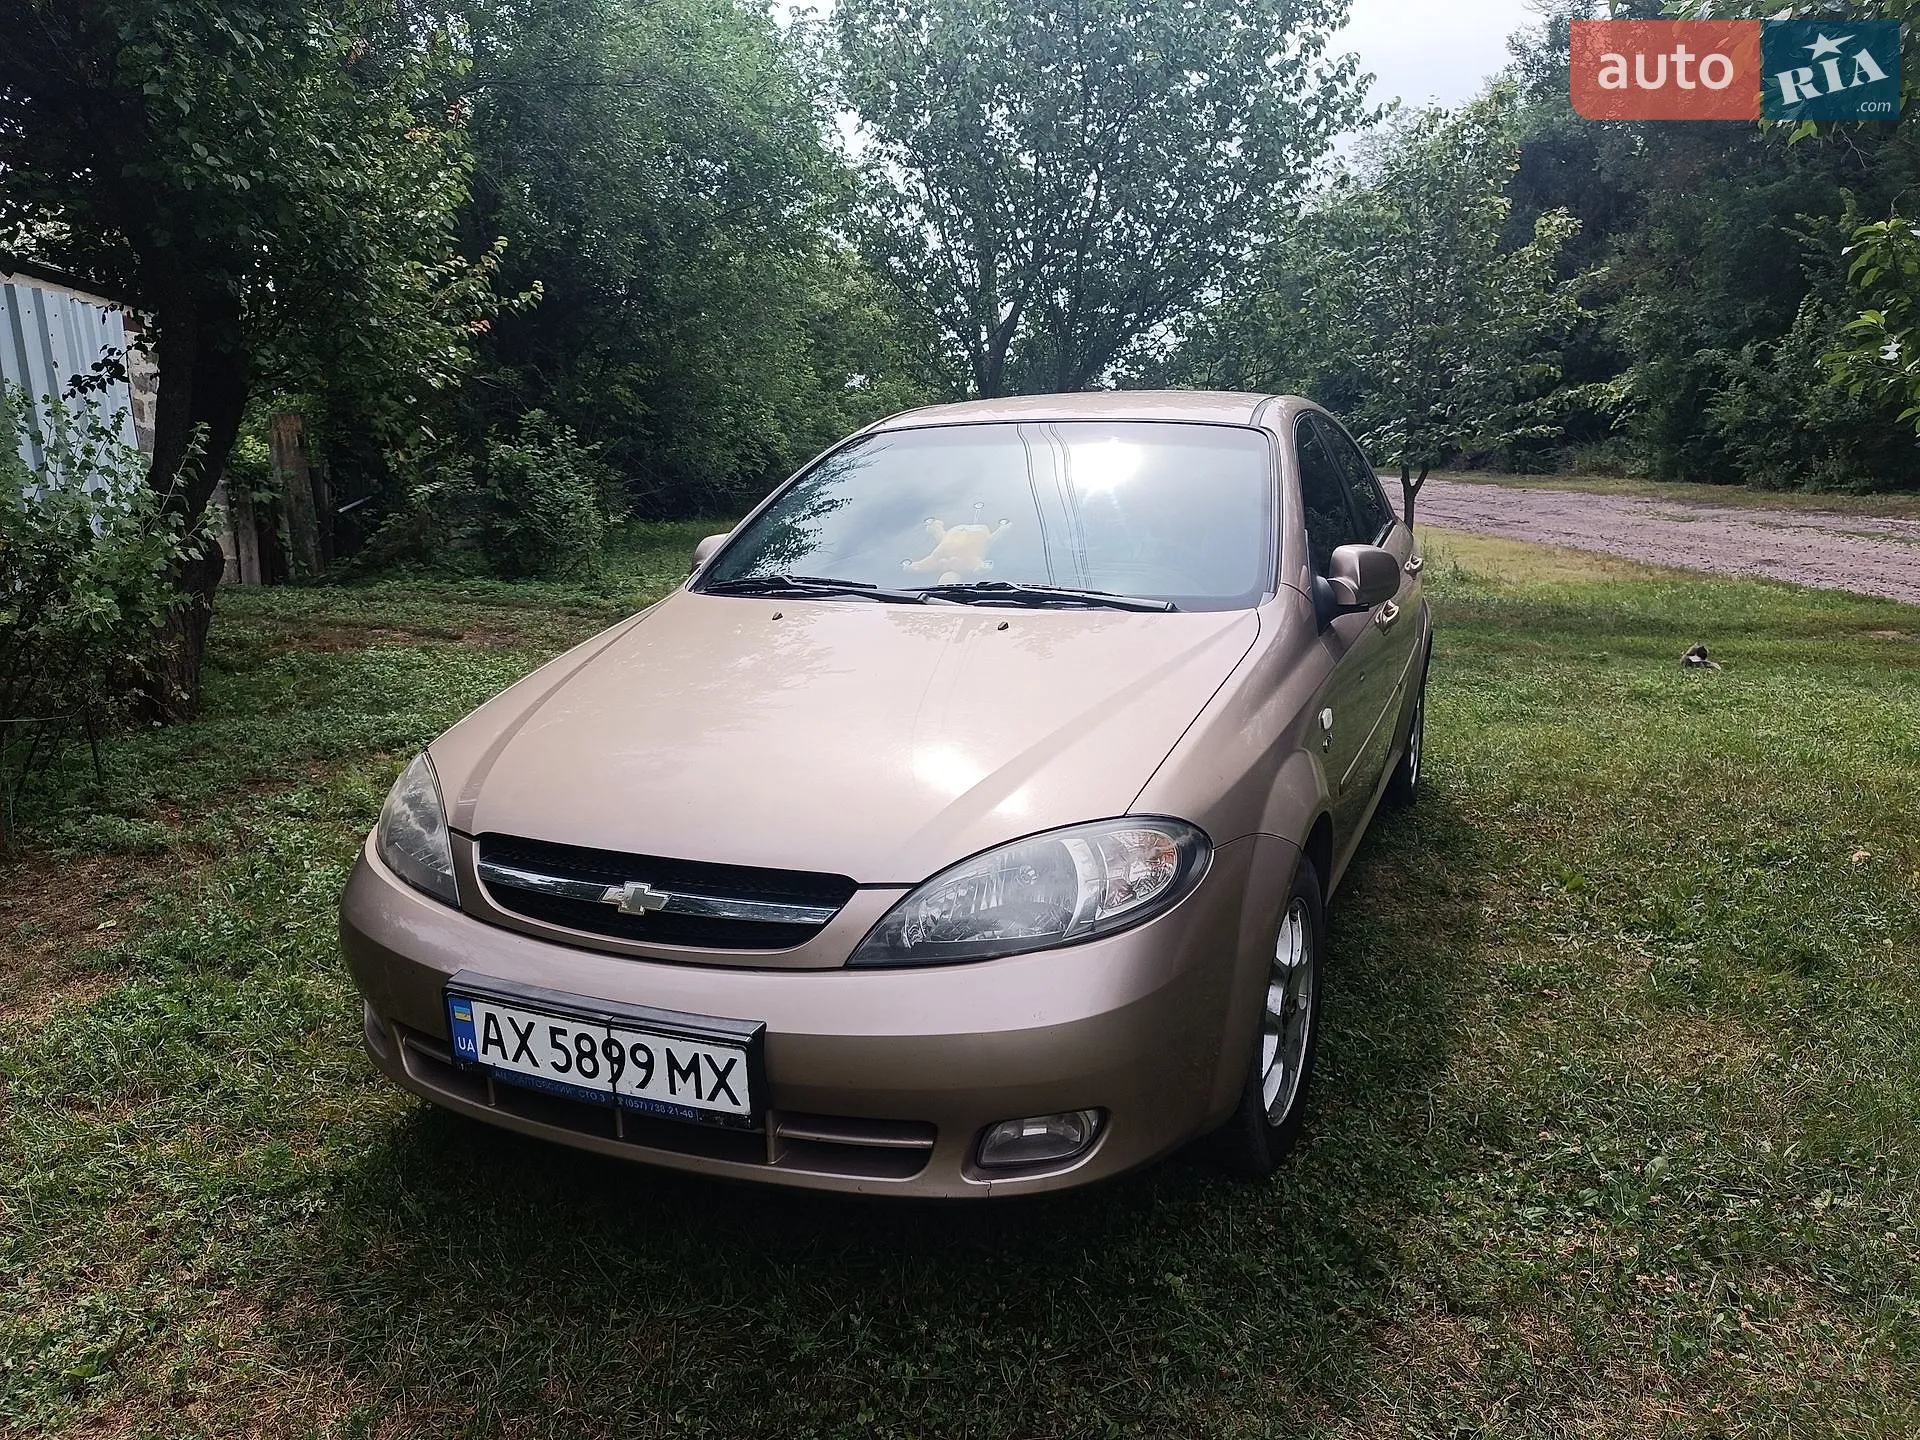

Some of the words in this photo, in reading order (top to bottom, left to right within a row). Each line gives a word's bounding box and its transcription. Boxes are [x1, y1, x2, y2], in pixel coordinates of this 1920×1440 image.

[458, 1036, 476, 1053] UA
[481, 1011, 540, 1069] AX
[549, 1026, 655, 1089] 5899
[667, 1047, 742, 1106] MX
